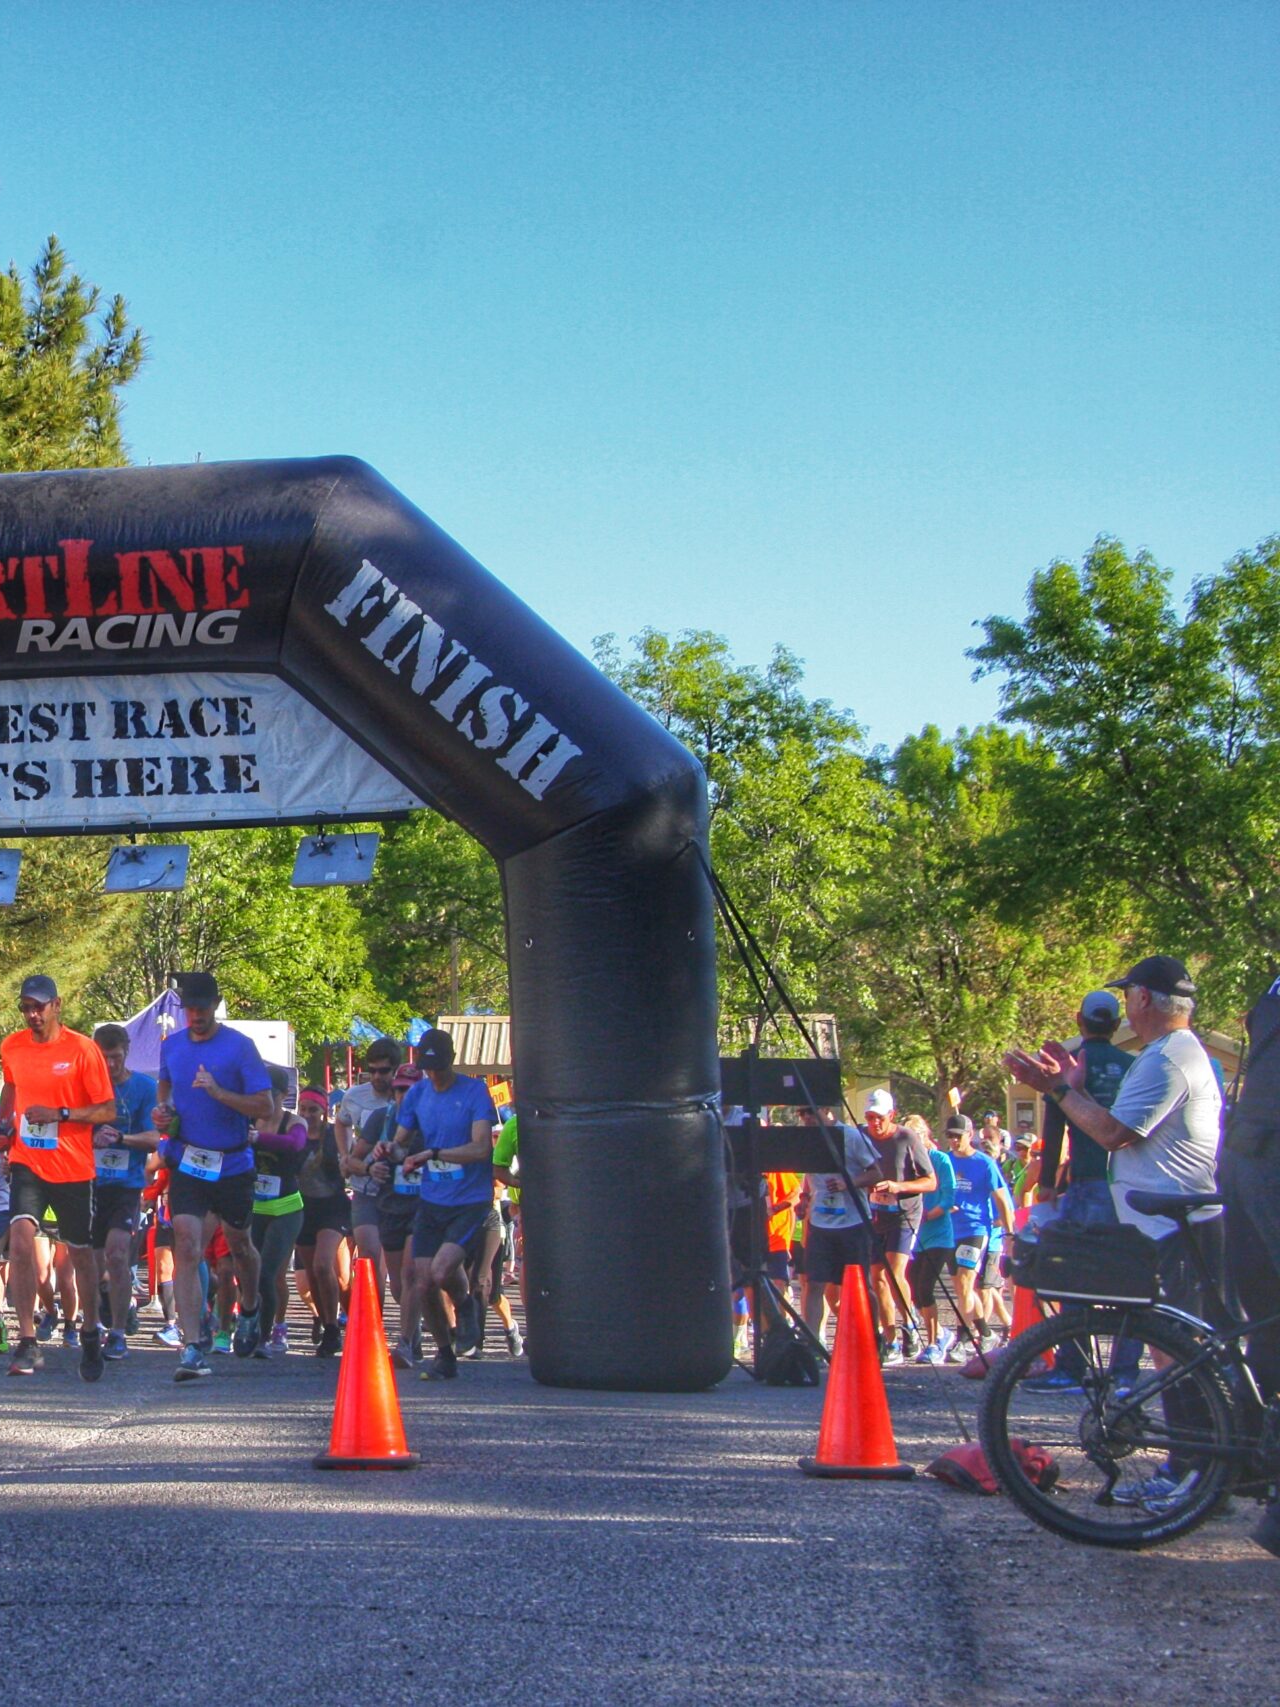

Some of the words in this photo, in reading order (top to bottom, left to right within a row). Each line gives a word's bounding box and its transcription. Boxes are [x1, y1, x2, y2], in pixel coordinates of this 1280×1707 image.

[16, 610, 241, 653] RACING
[324, 559, 583, 801] FINISH
[111, 697, 257, 740] RACE
[71, 754, 260, 798] HERE
